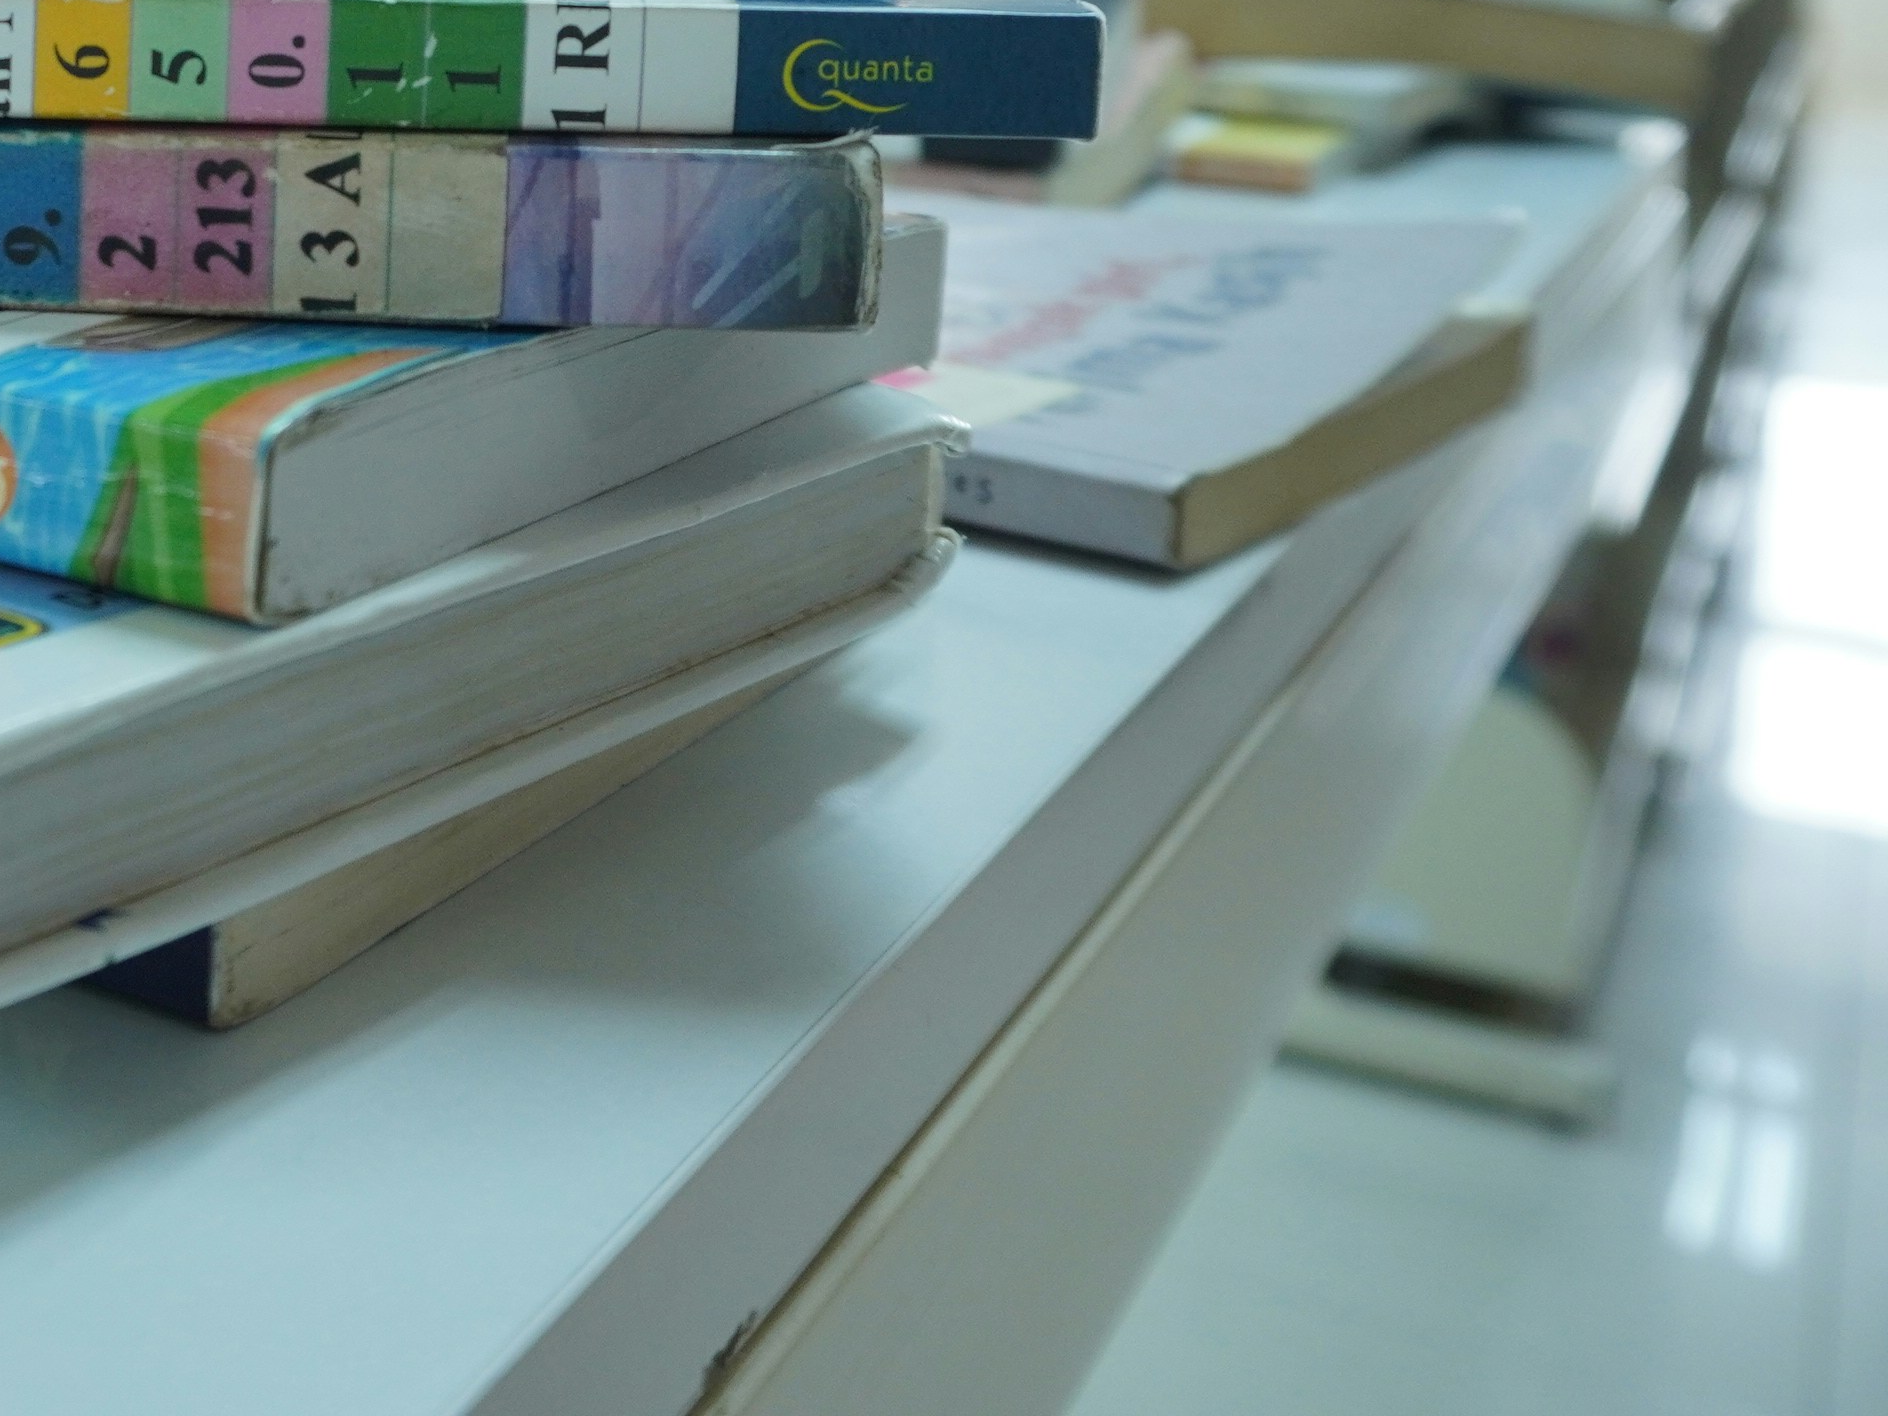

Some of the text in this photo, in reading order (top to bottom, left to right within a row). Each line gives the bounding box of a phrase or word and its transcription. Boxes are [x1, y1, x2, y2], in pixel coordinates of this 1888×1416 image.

[54, 34, 502, 94] 6 5 0. 1 1
[817, 55, 934, 92] quanta
[304, 133, 362, 207] A
[3, 208, 63, 266] 9.
[97, 233, 158, 272] 2
[193, 157, 257, 276] 213
[299, 229, 360, 268] 3
